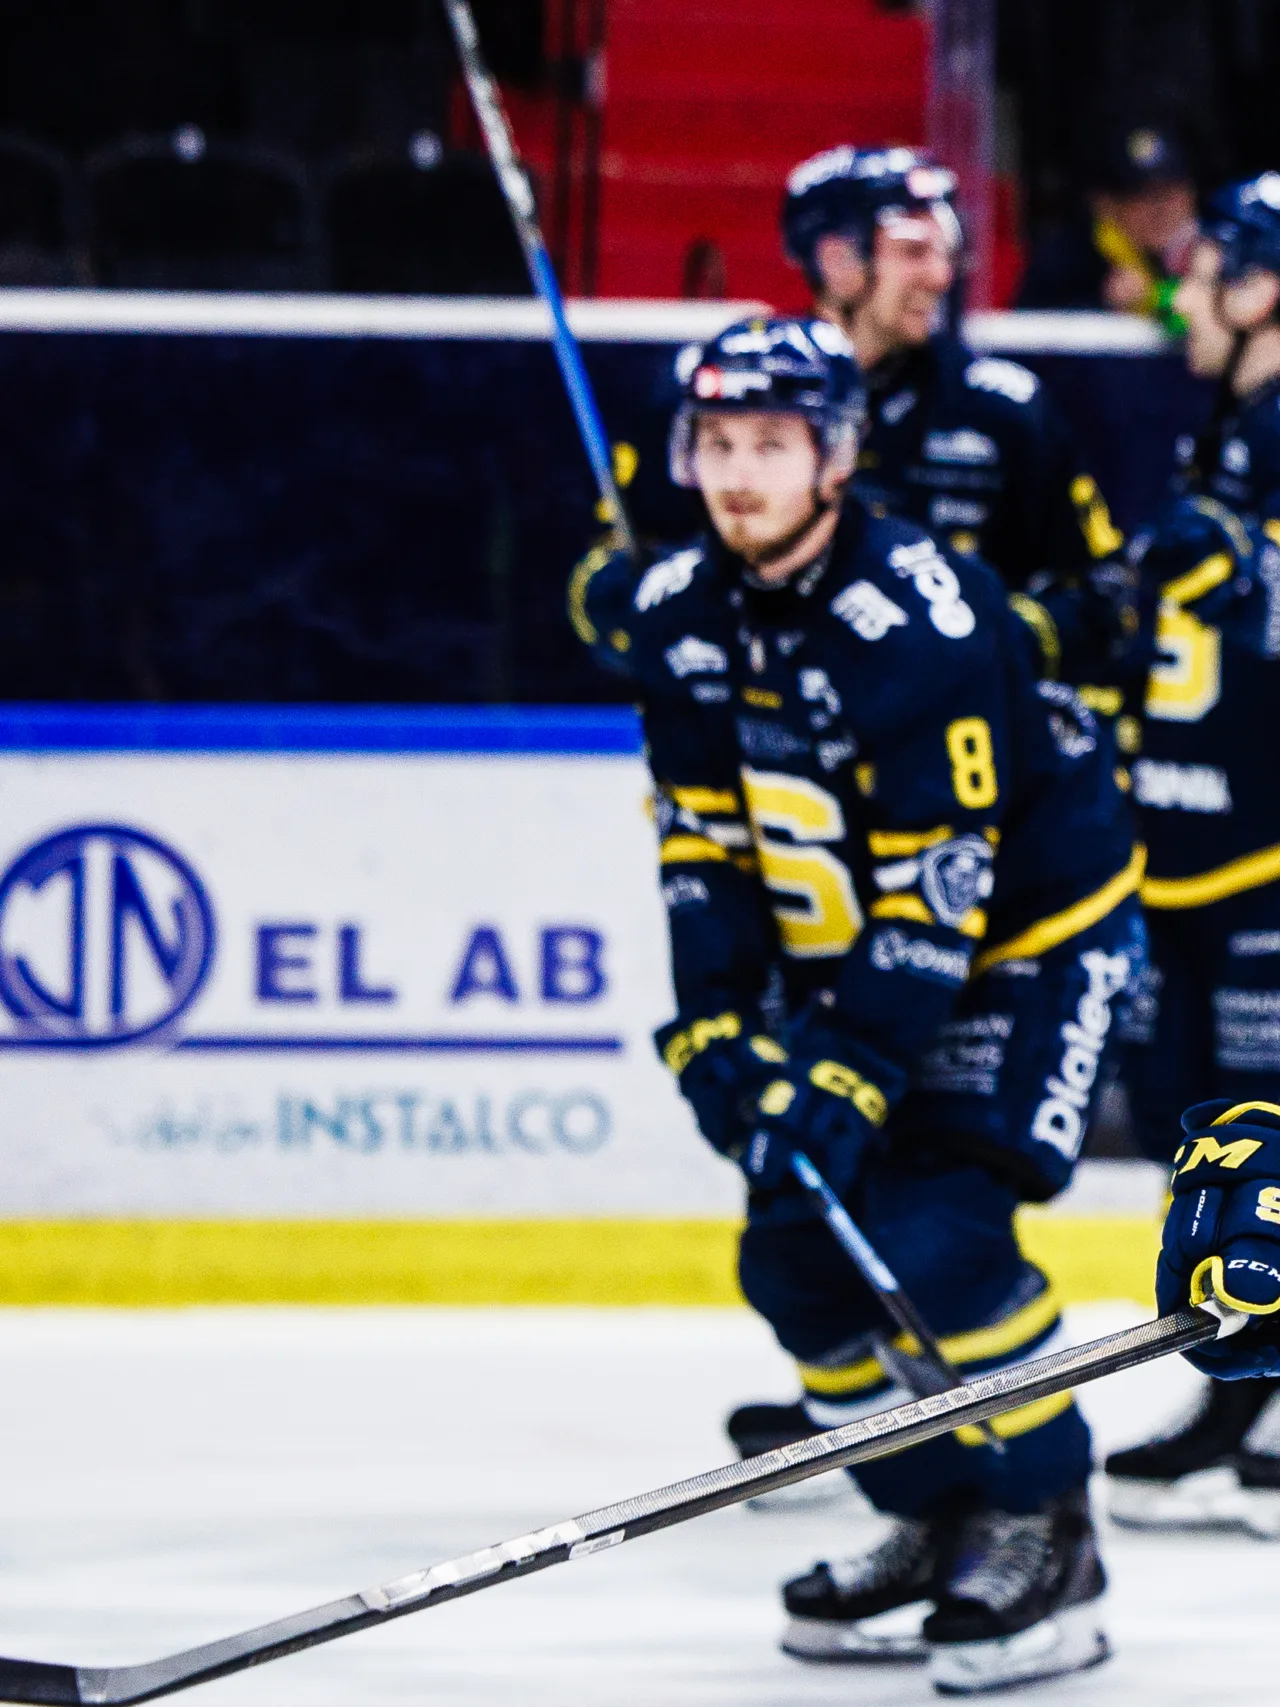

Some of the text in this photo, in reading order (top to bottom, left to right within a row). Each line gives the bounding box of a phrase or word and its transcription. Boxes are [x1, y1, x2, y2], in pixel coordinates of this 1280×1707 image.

[944, 714, 998, 809] 8
[255, 923, 609, 1006] EL AB
[276, 1090, 615, 1154] INSTALCO
